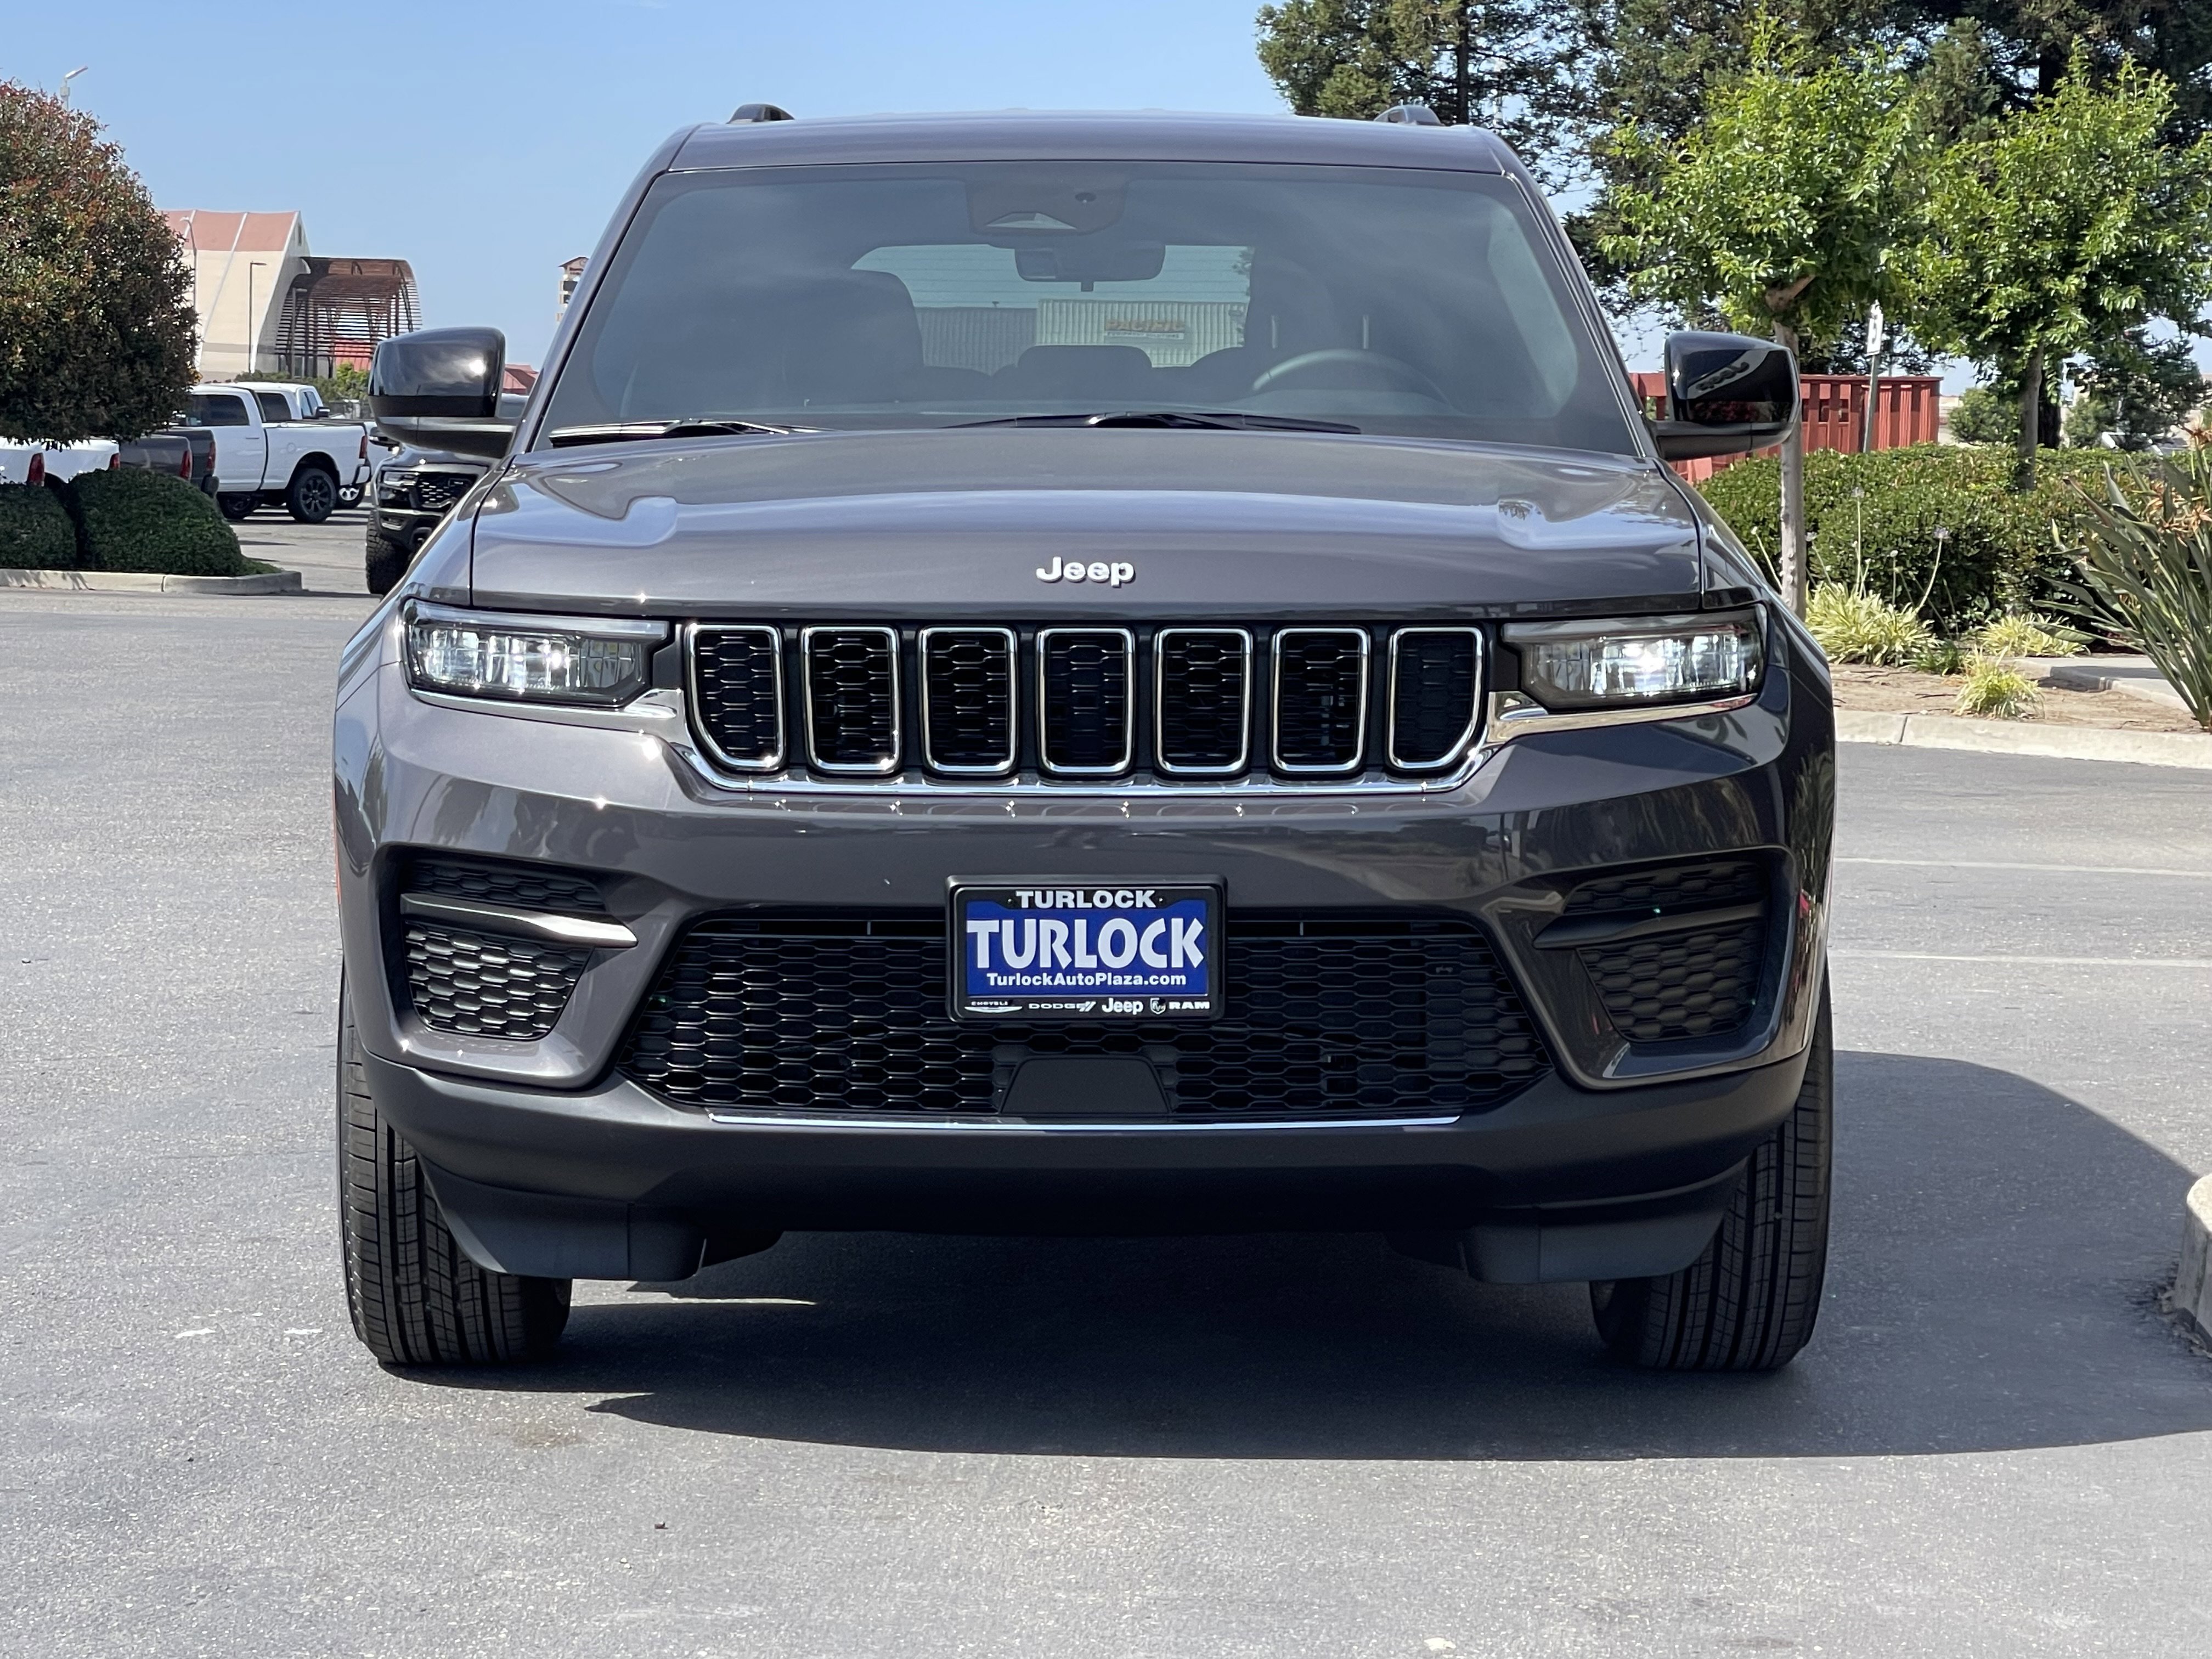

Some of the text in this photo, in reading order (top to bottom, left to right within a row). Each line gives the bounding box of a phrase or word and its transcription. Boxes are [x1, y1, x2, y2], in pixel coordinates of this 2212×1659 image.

[1036, 556, 1135, 587] Jeep
[1015, 890, 1156, 908] TURLOCK
[967, 918, 1204, 969] TURLOCK
[987, 973, 1187, 986] TurlockAutoPlaza.com
[1102, 997, 1143, 1015] Jeep
[1169, 1001, 1210, 1009] RAM
